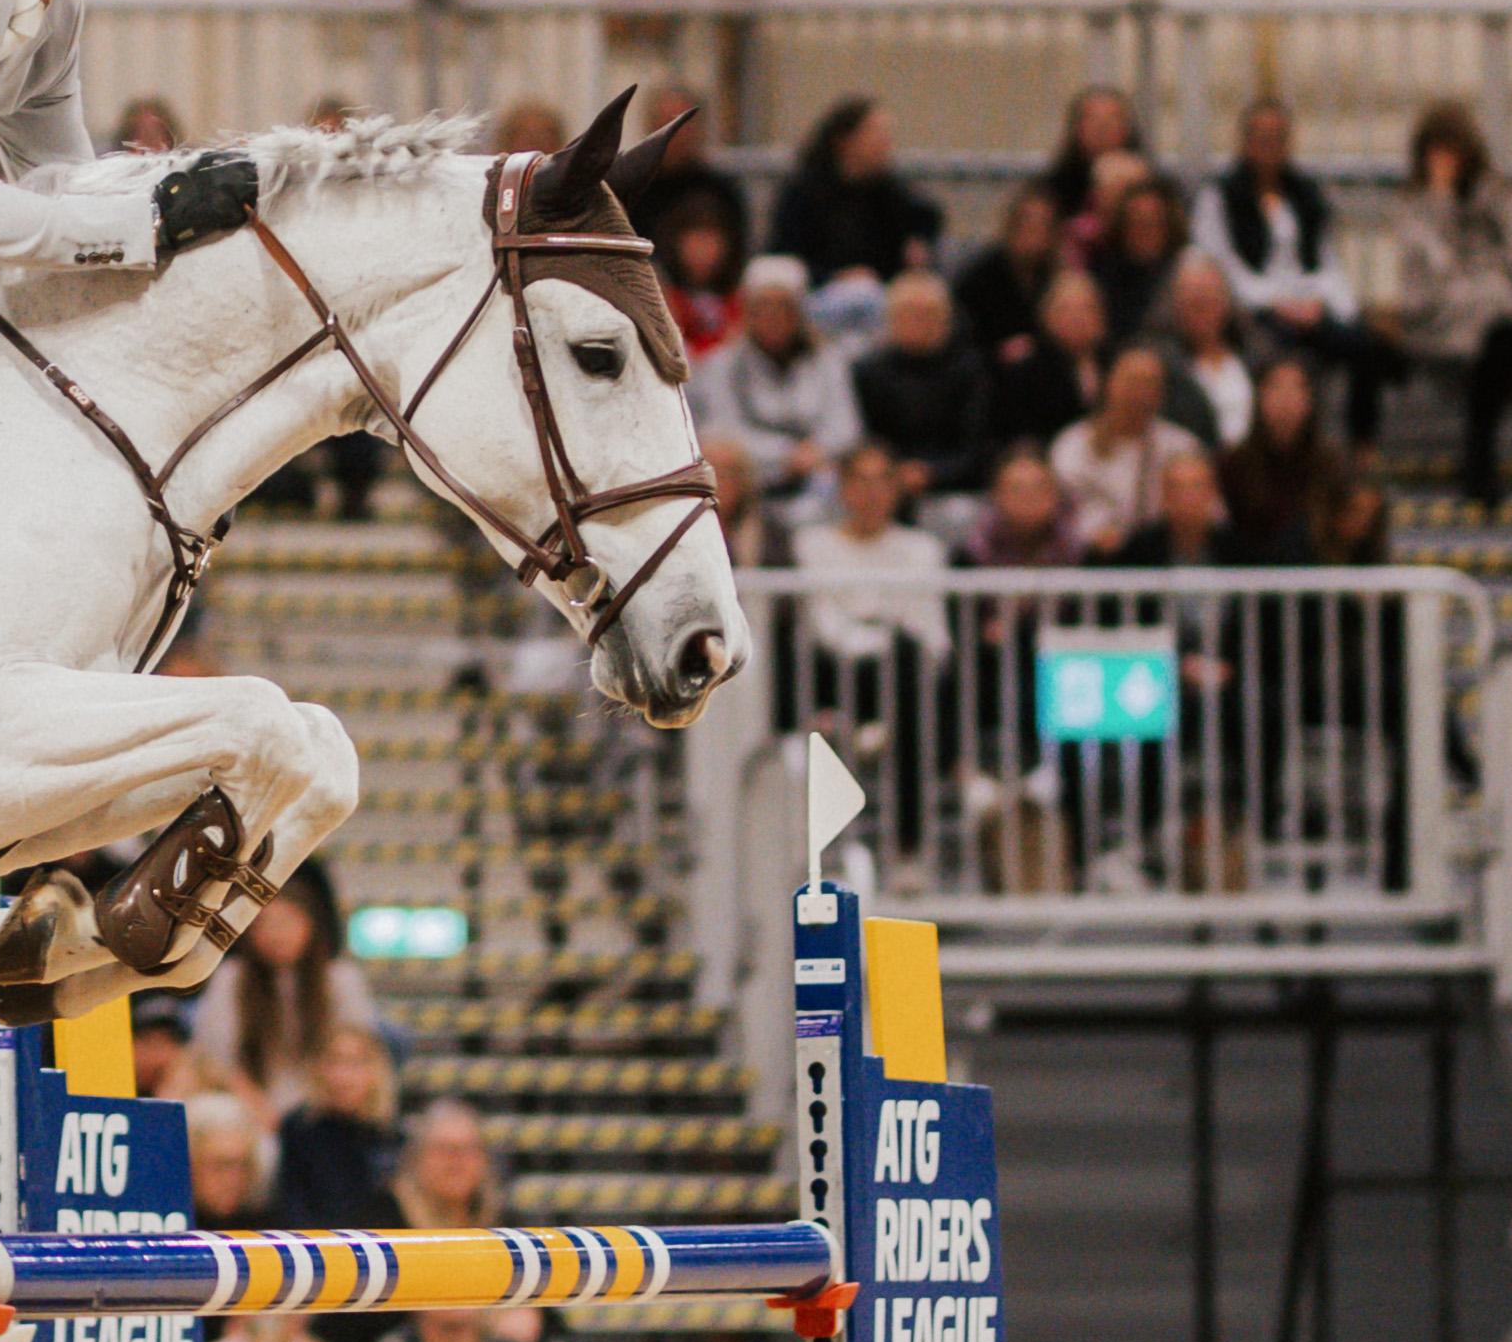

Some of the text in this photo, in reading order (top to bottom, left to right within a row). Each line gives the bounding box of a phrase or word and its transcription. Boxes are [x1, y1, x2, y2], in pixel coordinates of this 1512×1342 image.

[55, 1112, 130, 1197] ATG
[874, 1099, 941, 1184] ATG
[875, 1197, 992, 1283] RIDERS
